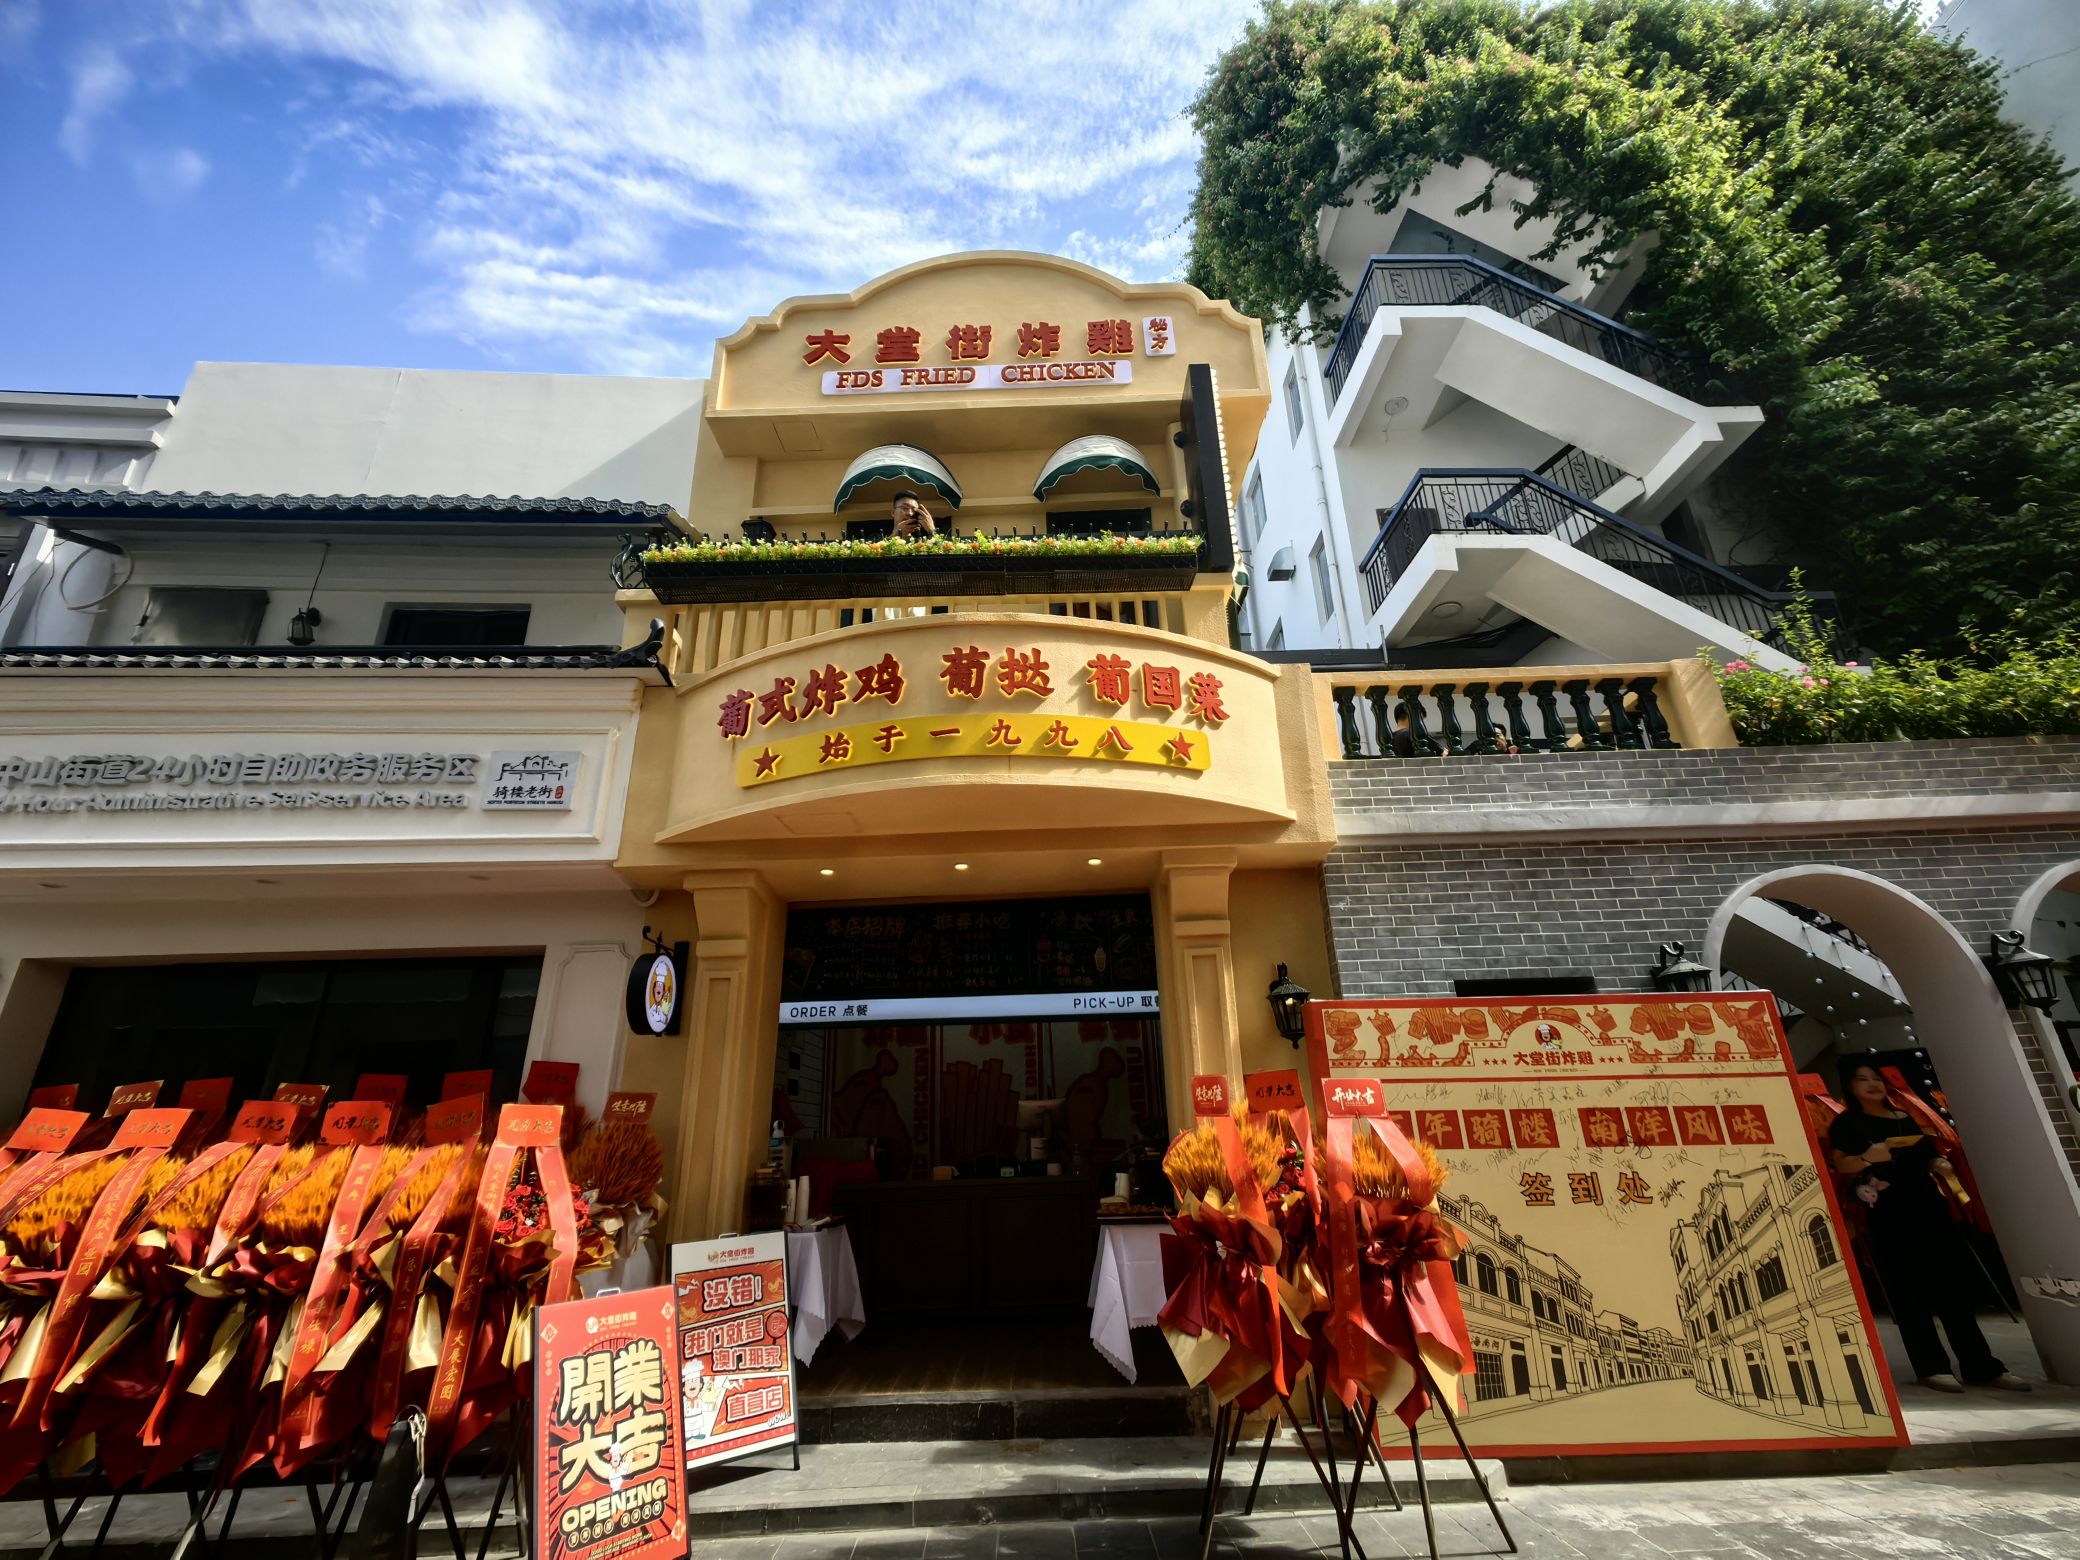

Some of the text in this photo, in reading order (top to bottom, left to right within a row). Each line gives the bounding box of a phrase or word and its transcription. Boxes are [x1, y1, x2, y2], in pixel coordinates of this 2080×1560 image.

[836, 361, 1117, 389] FDS FRIED CHICKEN
[718, 645, 1232, 739] 葡式炸鸡 葡挞 葡国菜
[818, 718, 1134, 764] 始于一九九八
[790, 1004, 869, 1019] ORDER 点餐
[1073, 996, 1135, 1009] PICK-UP
[1332, 1086, 1375, 1110] 开业大吉
[1588, 1106, 1767, 1145] 南洋风味
[1520, 1171, 1654, 1206] 签到处
[686, 1315, 764, 1357] 我们就是
[713, 1346, 782, 1370] 澳门那家
[560, 1340, 662, 1422] 開業
[728, 1386, 784, 1420] 直营店
[561, 1409, 666, 1491] 大吉
[561, 1478, 667, 1533] OPENING
